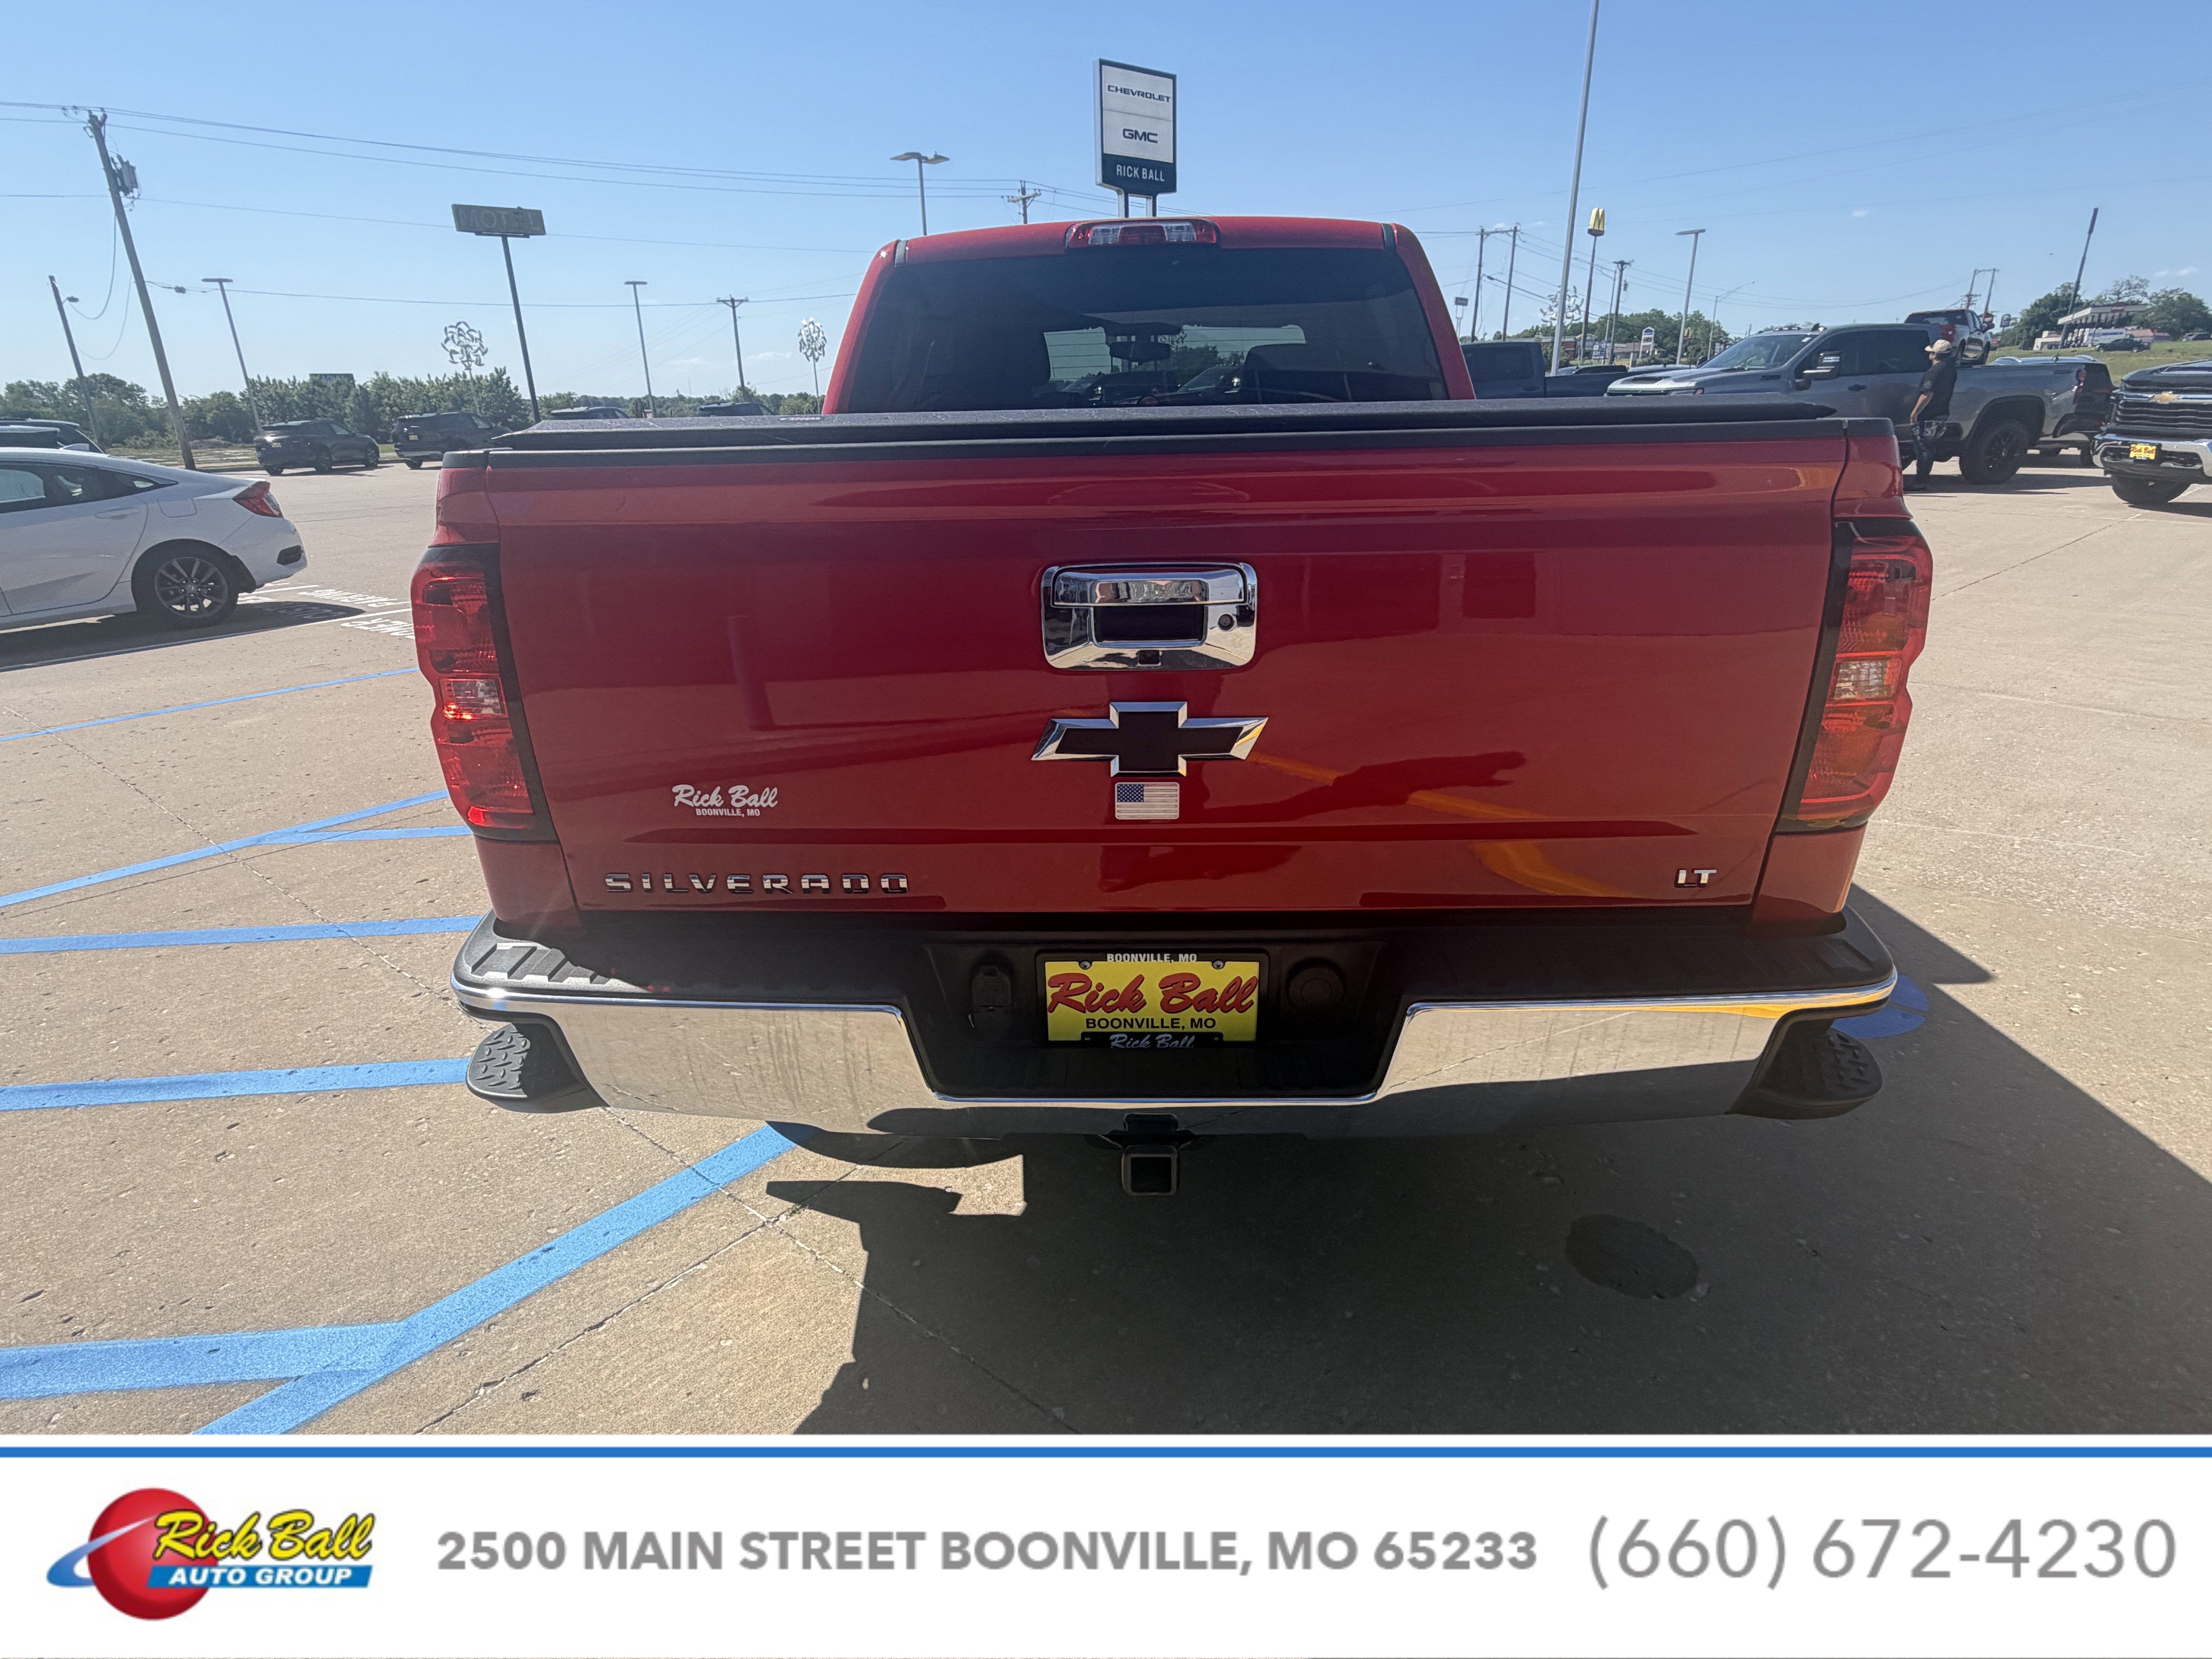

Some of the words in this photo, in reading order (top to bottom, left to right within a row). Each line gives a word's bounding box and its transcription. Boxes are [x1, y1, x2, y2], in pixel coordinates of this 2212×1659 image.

[1107, 85, 1171, 103] CHEVROLET
[1123, 129, 1158, 143] GMC
[1116, 164, 1139, 179] RICK
[1142, 168, 1165, 182] BALL
[459, 209, 541, 231] MOTEL
[672, 784, 724, 807] Rick
[728, 784, 778, 808] Ball
[696, 808, 745, 817] BOONVILLE,
[747, 808, 761, 816] MO
[605, 873, 908, 894] SILVERADO
[1674, 869, 1717, 888] LT
[1107, 953, 1174, 963] BOONVILLE,
[1179, 953, 1197, 963] MO
[1047, 972, 1147, 1014] Rick
[1158, 972, 1258, 1014] Ball
[1085, 1018, 1185, 1030] BOONVILLE,
[1190, 1018, 1216, 1029] MO
[1109, 1034, 1151, 1049] Rick
[1155, 1034, 1196, 1049] Ball
